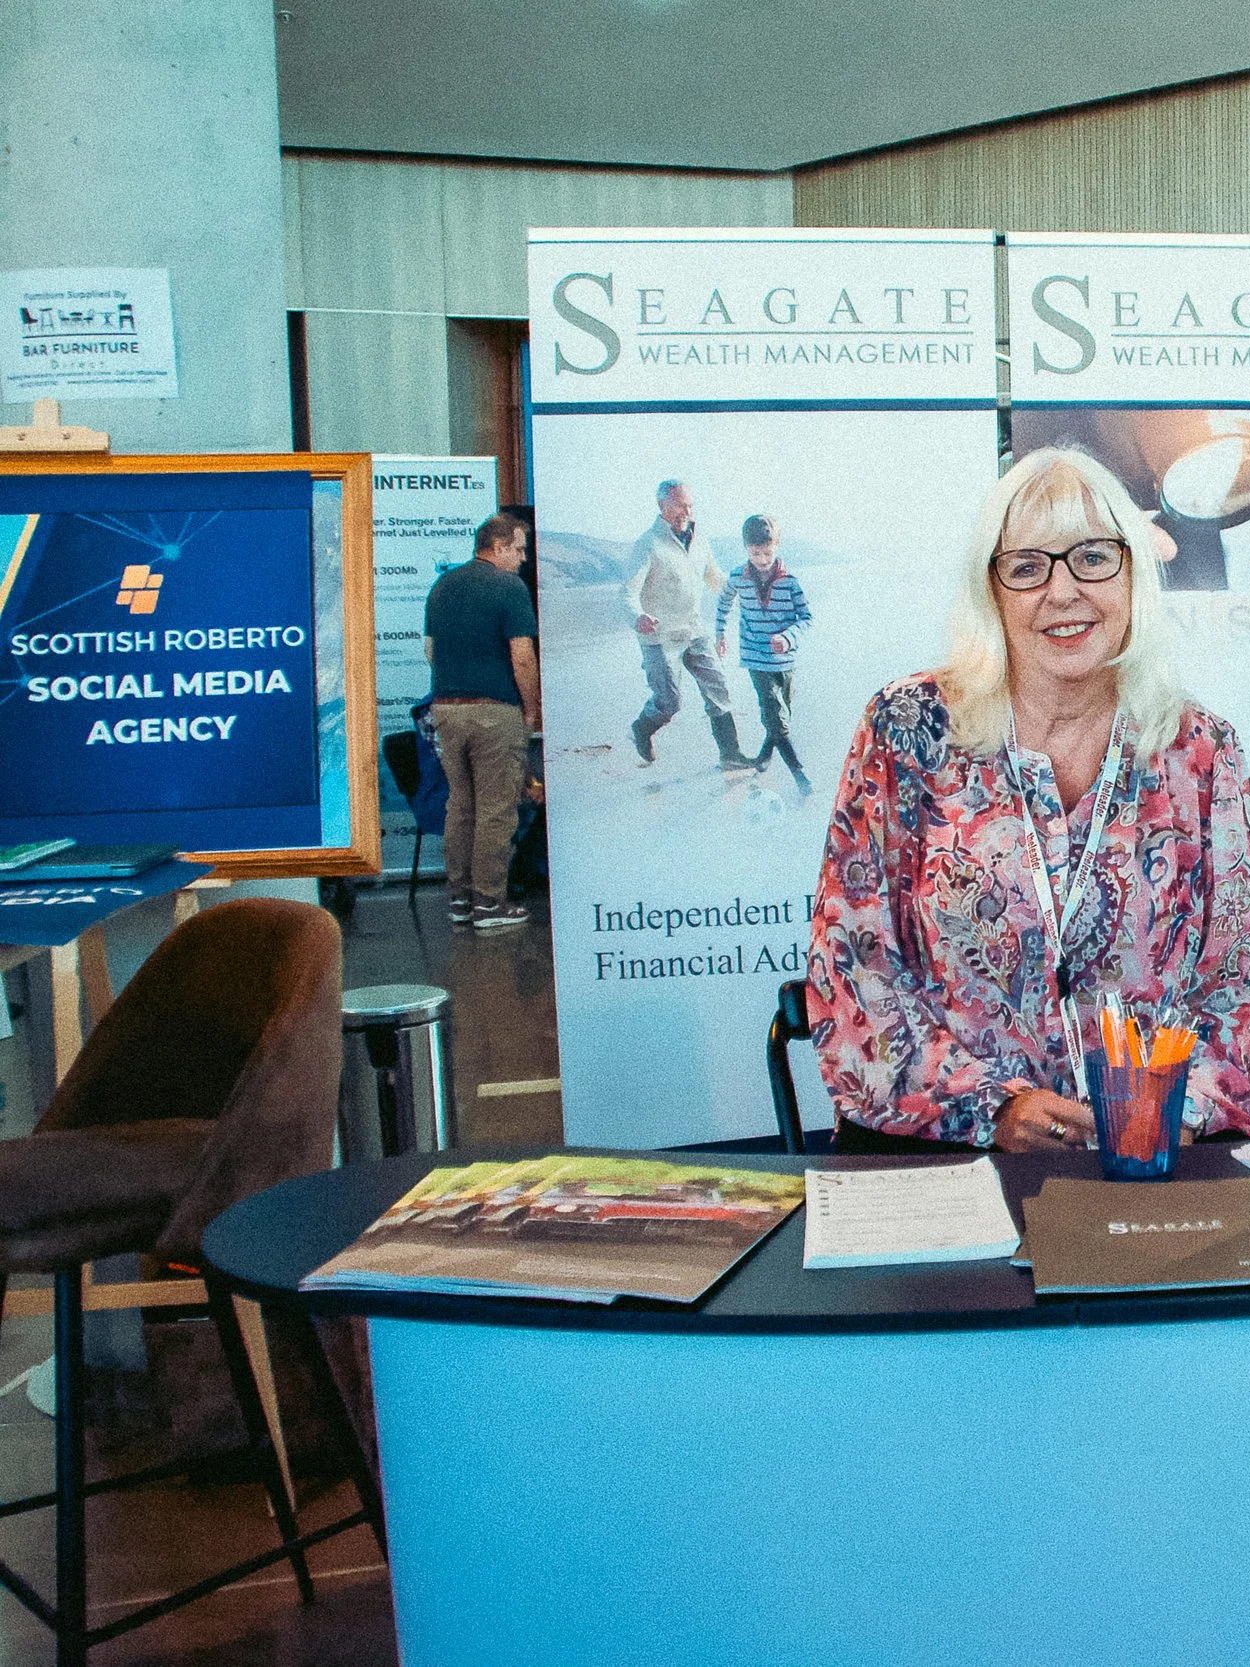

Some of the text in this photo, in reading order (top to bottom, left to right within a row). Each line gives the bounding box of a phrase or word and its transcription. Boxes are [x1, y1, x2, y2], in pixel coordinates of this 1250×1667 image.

[552, 271, 972, 376] SEAGATE
[23, 342, 139, 357] BAR FURNITURE
[638, 343, 974, 366] WEALTH MANAGEMENT
[1112, 346, 1220, 367] WEALTH
[399, 528, 421, 538] Just
[423, 528, 466, 537] Levelled
[11, 626, 306, 656] SCOTTISH ROBERTO
[28, 669, 292, 702] SOCIAL MEDIA
[86, 715, 237, 745] AGENCY
[0, 895, 96, 905] DIA
[593, 897, 792, 938] Independent
[594, 945, 745, 981] Financial
